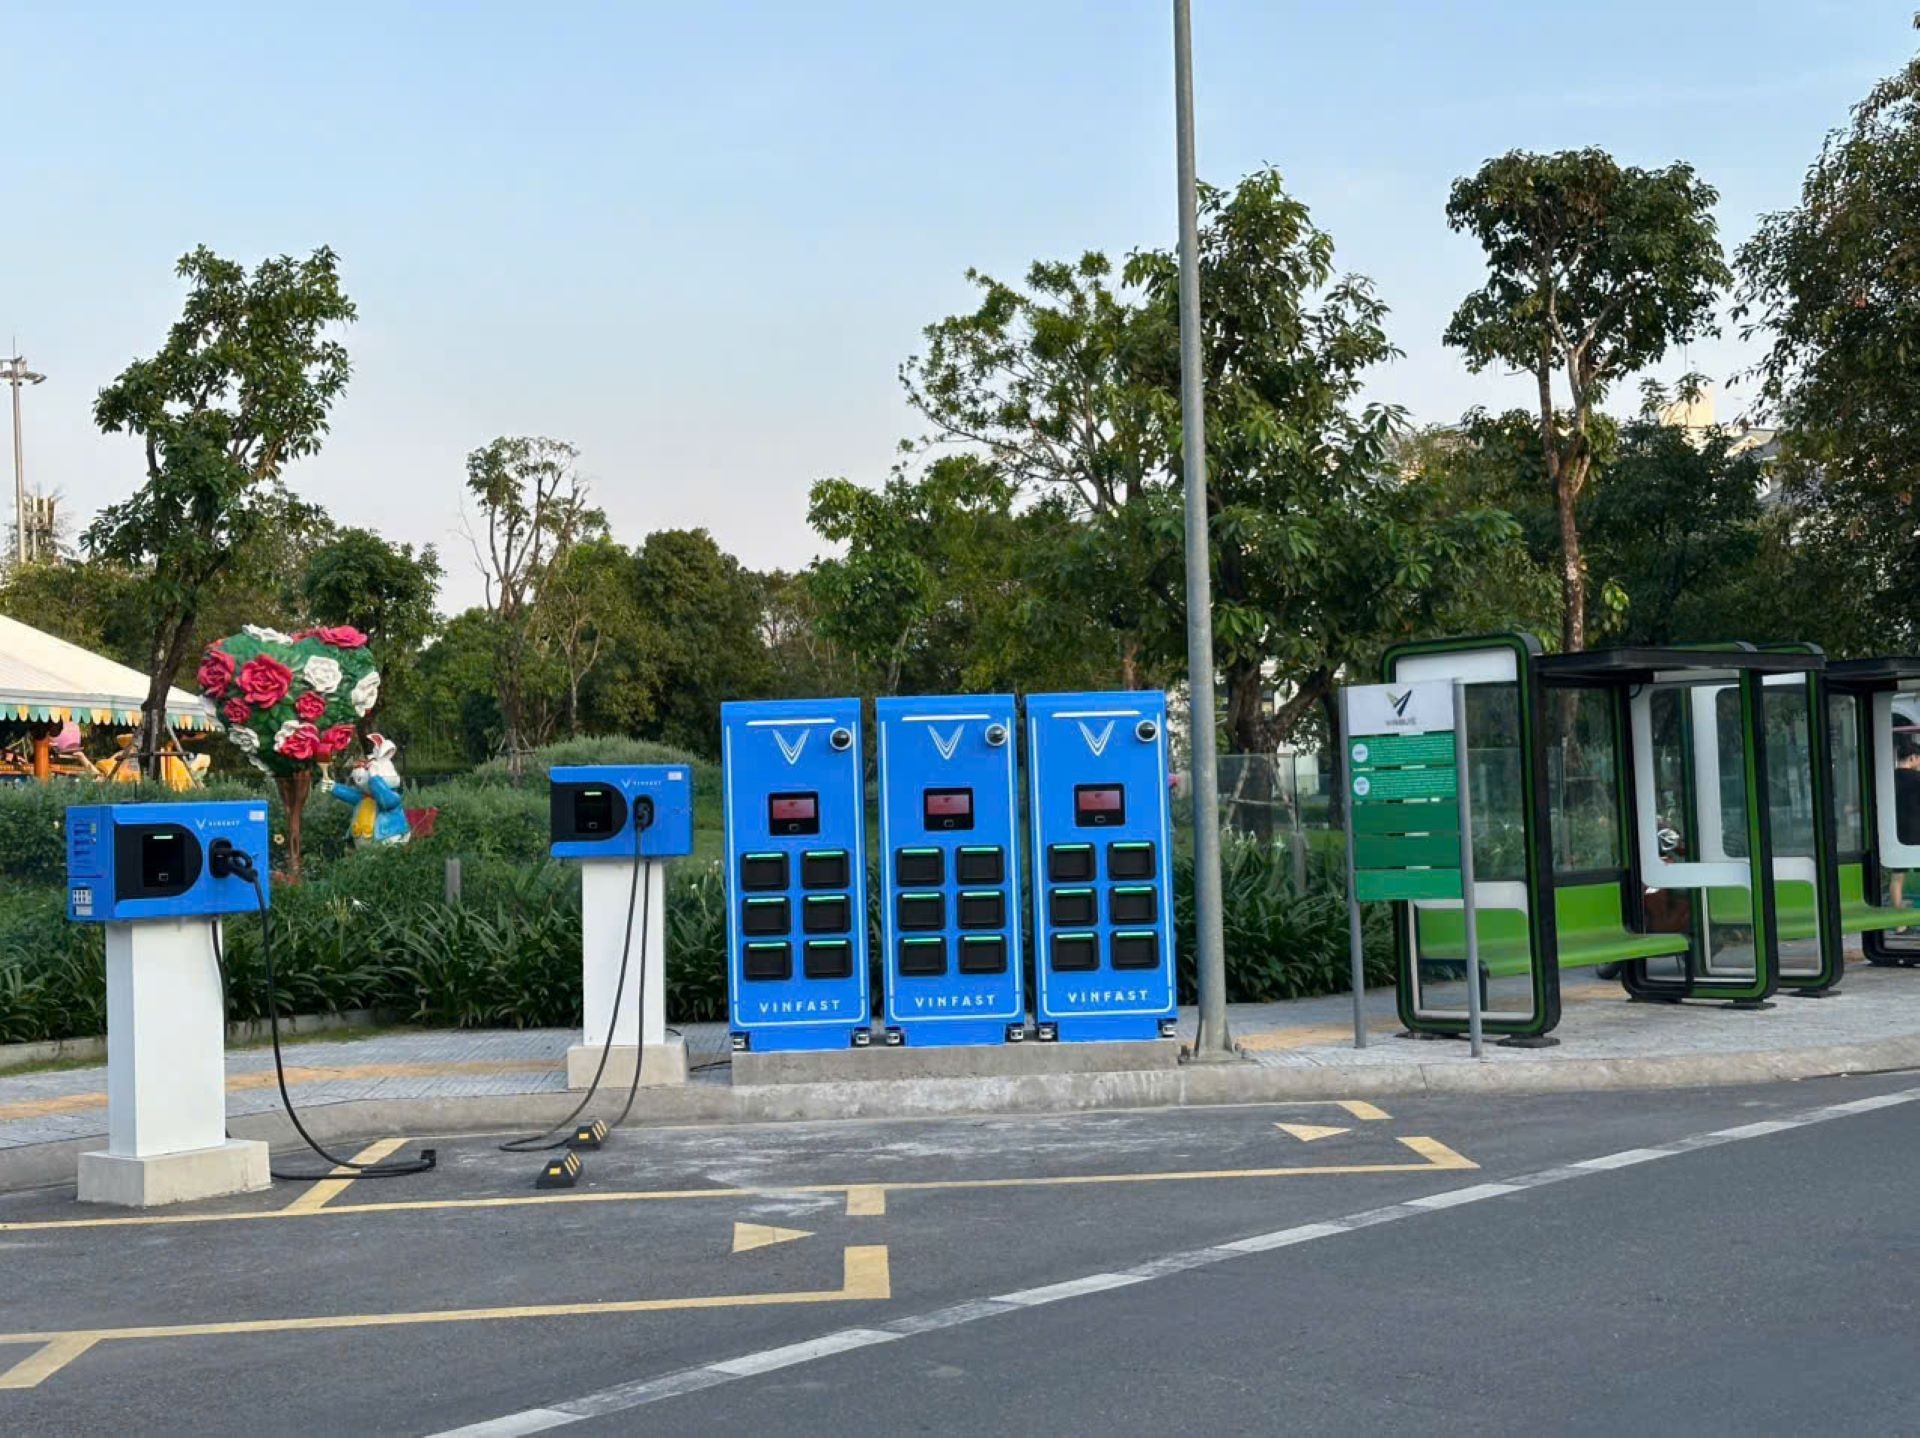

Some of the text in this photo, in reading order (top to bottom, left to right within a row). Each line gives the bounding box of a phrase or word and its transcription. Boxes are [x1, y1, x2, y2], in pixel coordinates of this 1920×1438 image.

[914, 994, 995, 1008] VINFAST
[1068, 989, 1148, 1003] VINFAST
[759, 999, 840, 1013] VINFAST
